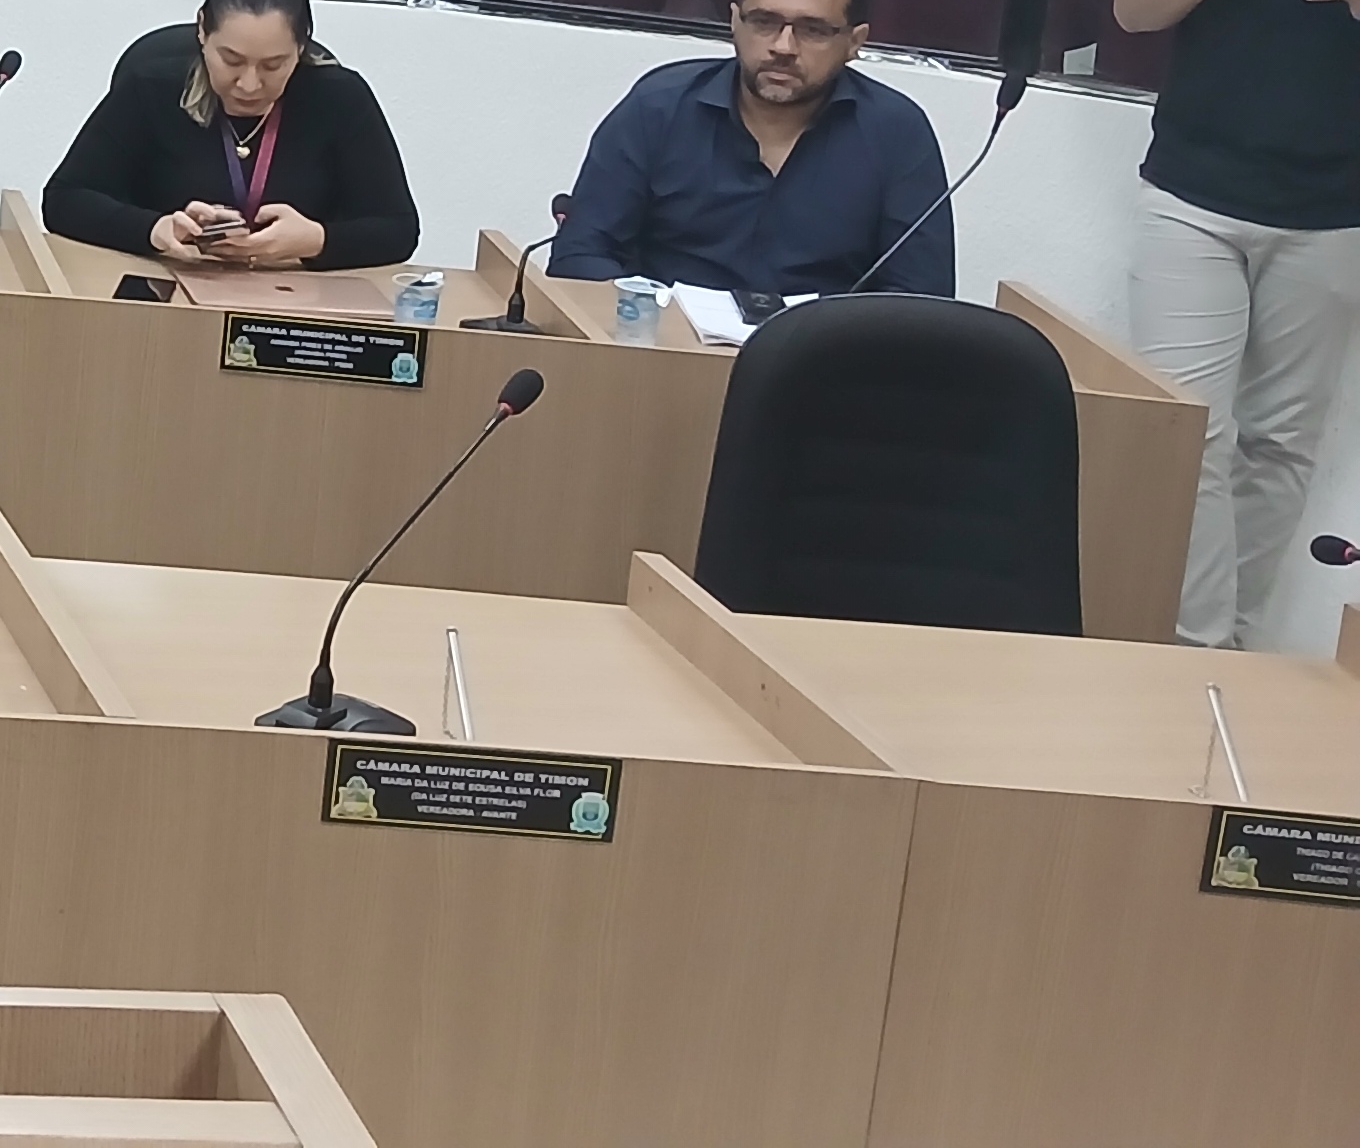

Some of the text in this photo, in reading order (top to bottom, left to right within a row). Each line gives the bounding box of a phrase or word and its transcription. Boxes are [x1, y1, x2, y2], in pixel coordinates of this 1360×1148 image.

[356, 759, 590, 787] CÂMARA MUNICIPAL DE TIMON
[1242, 824, 1313, 840] CÂMARA
